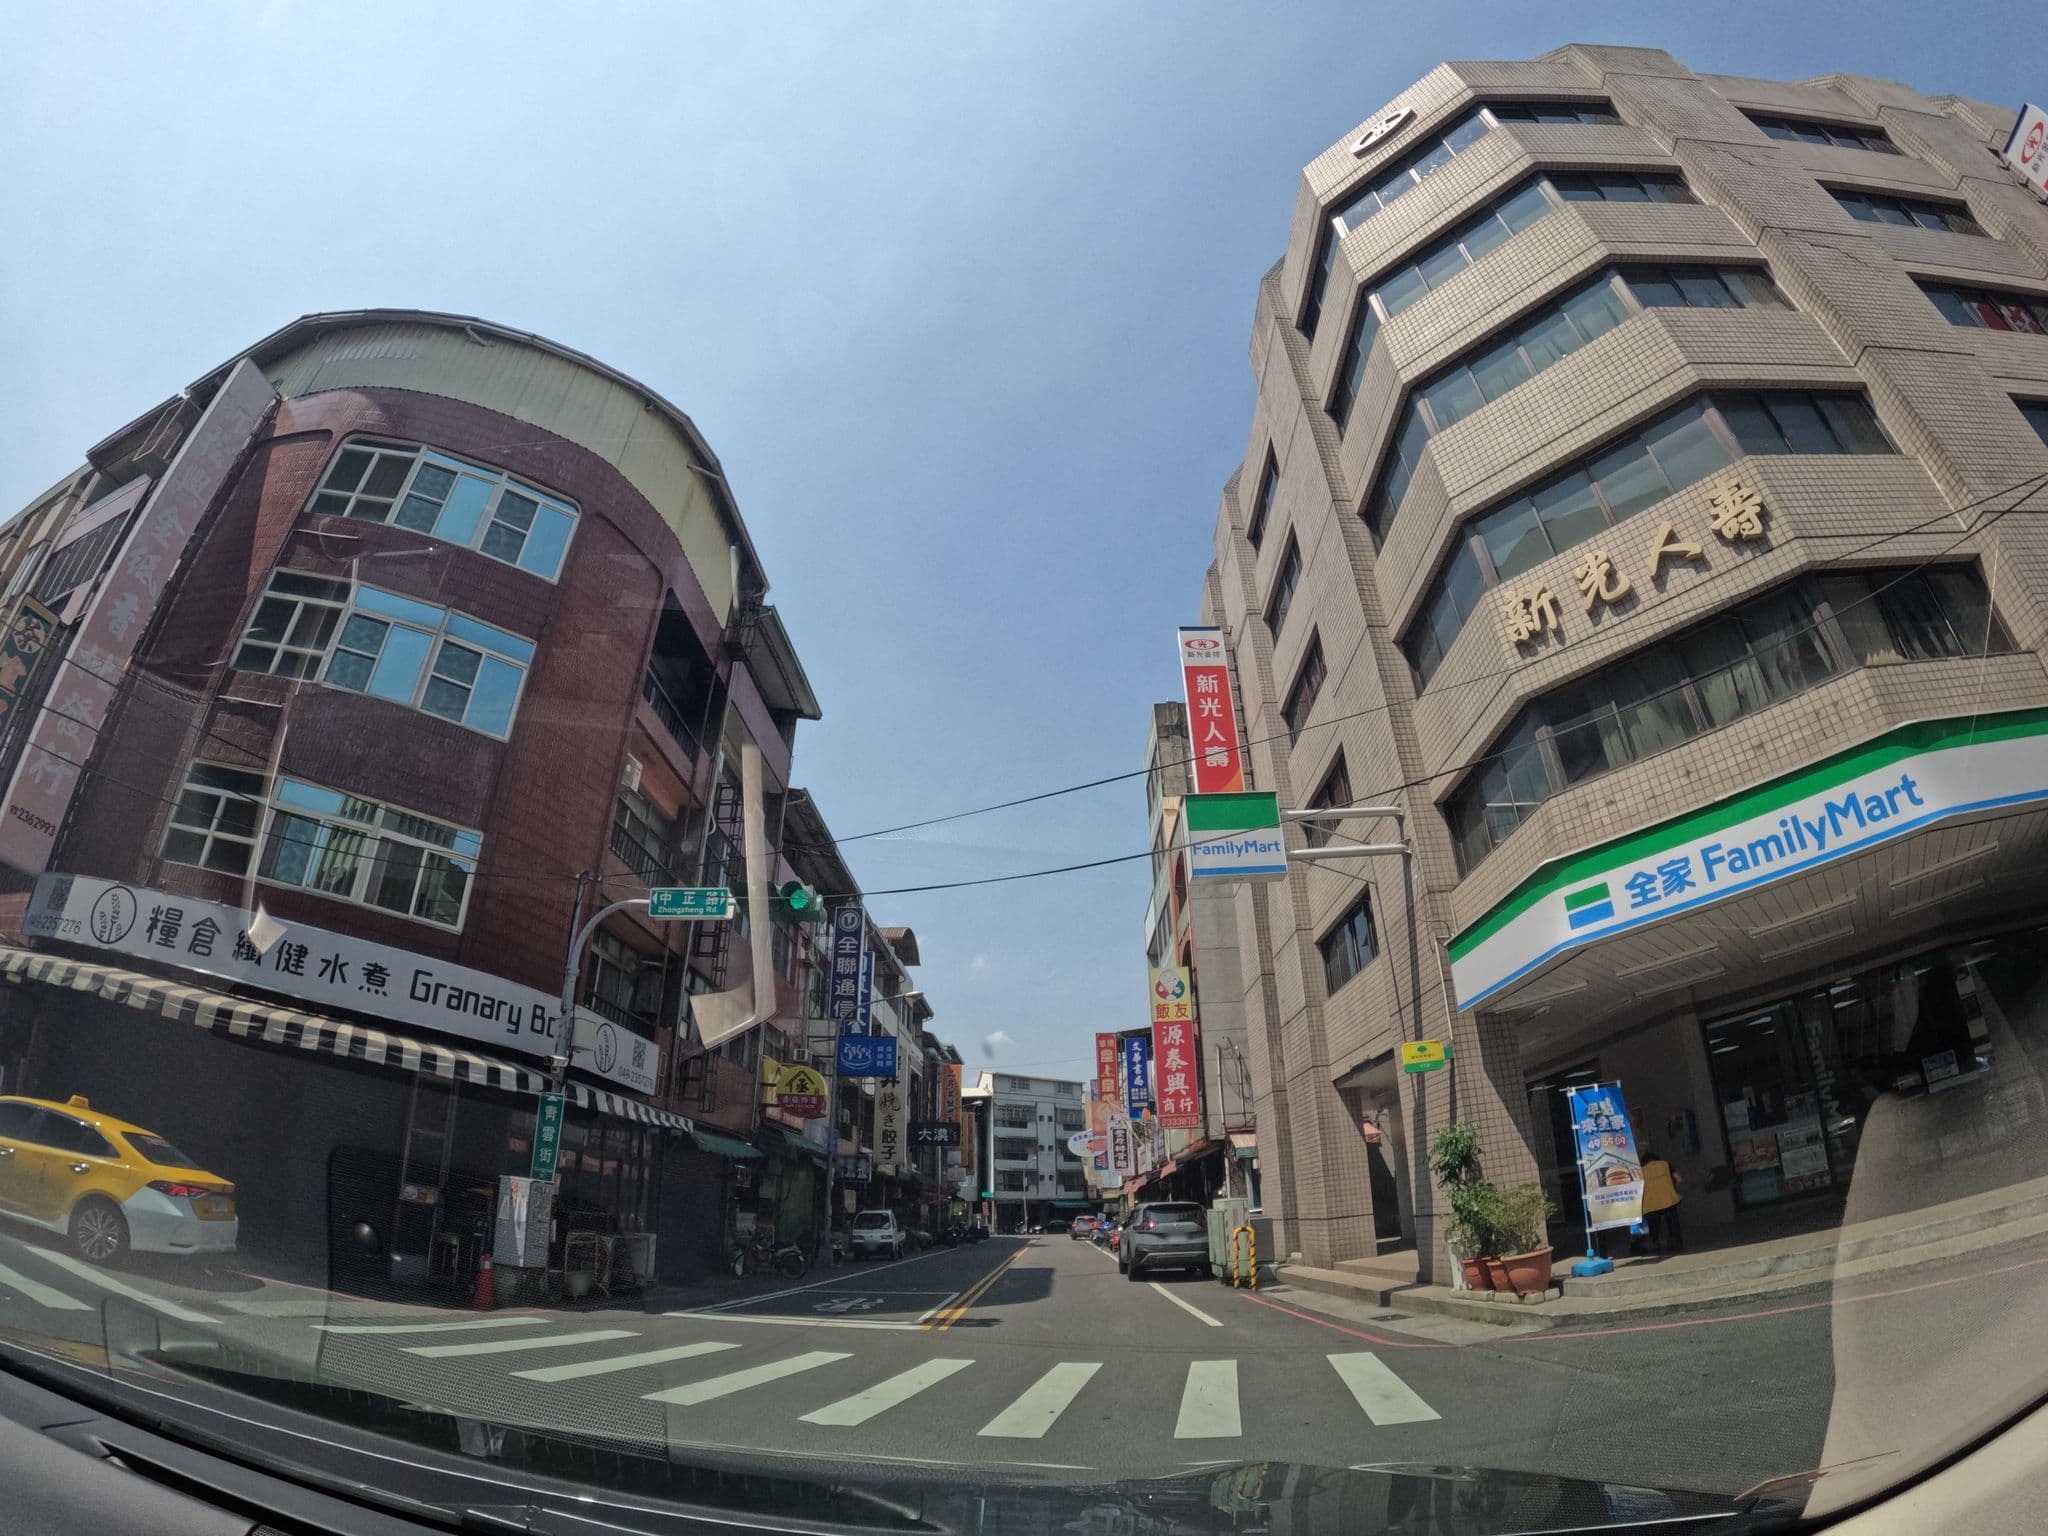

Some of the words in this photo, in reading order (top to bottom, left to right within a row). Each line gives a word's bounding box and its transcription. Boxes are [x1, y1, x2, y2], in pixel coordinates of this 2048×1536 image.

[1502, 477, 1763, 644] 新光人壽
[1196, 674, 1230, 767] 新光人壽
[1193, 839, 1281, 857] FamilyMart
[1624, 858, 1697, 910] 全家
[1700, 773, 1925, 883] FamilyMart
[657, 906, 703, 914] Zhongzheng
[659, 891, 718, 905] 中正路
[409, 969, 524, 1035] Granary
[833, 937, 859, 1018] 全聯通信
[1162, 1025, 1190, 1096] 源泰興
[1162, 1098, 1194, 1113] 商行
